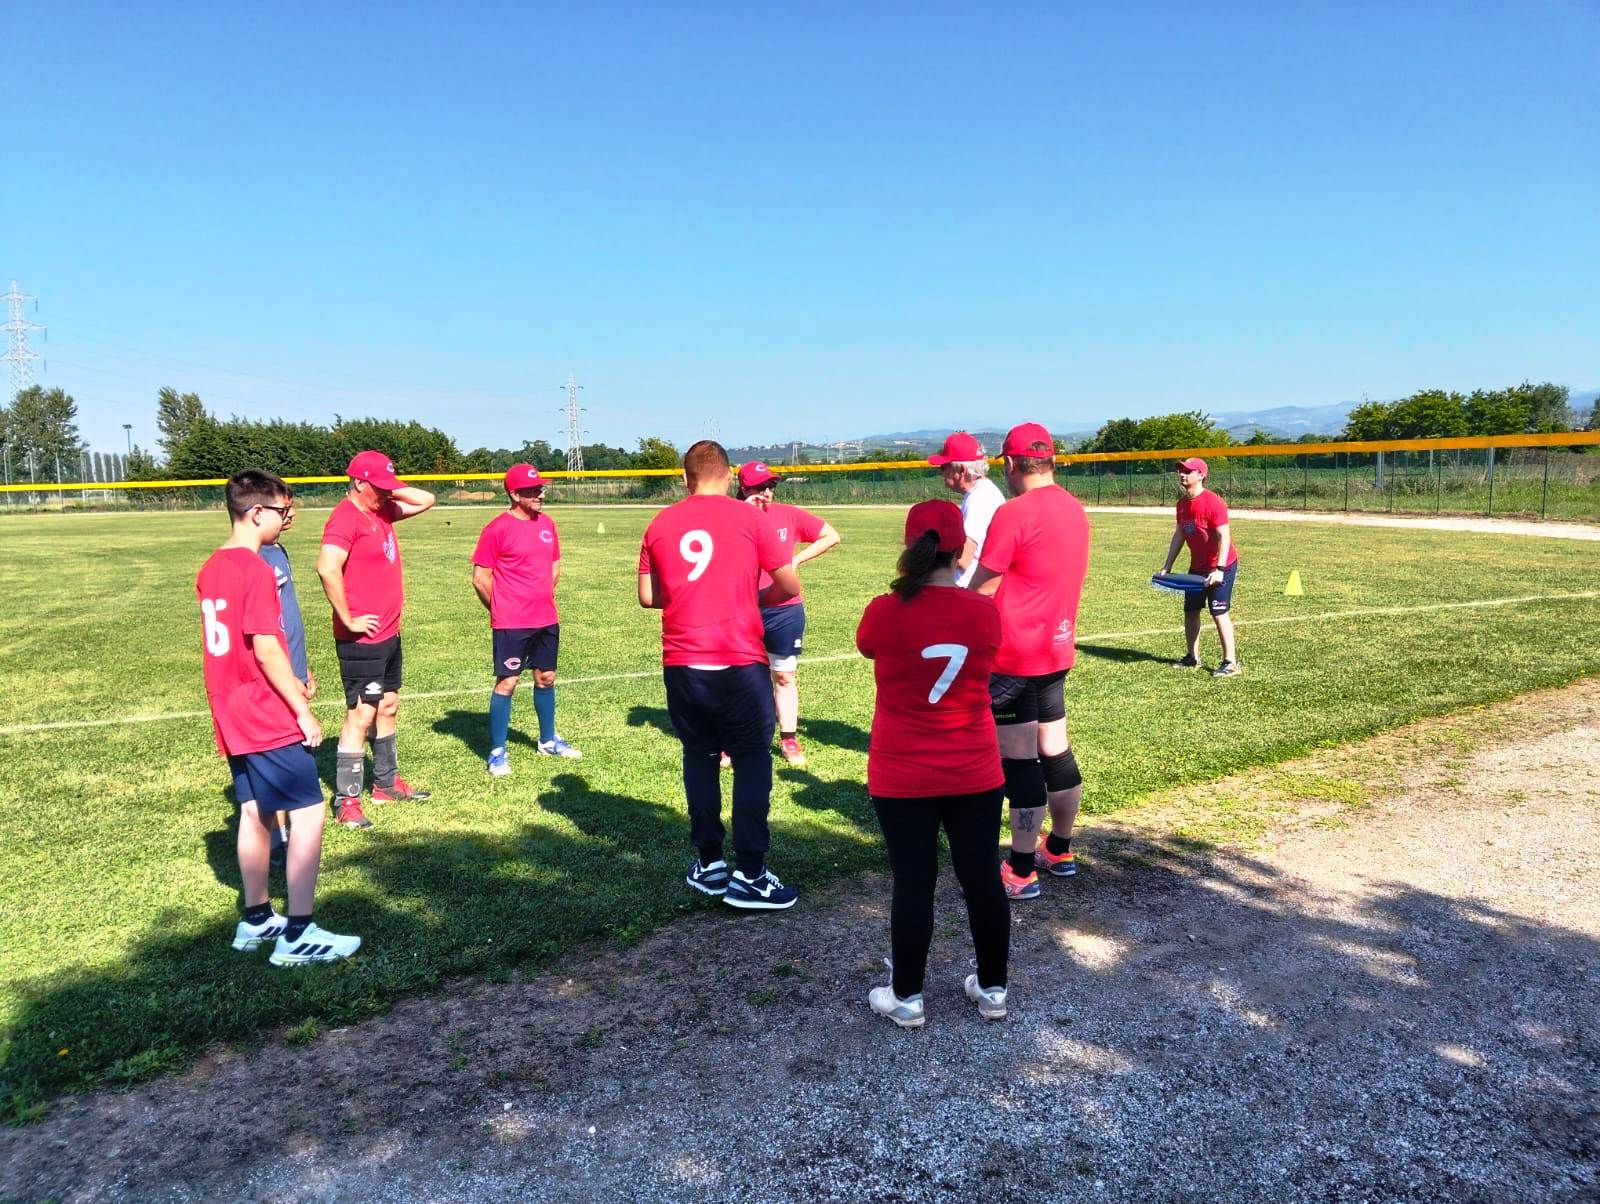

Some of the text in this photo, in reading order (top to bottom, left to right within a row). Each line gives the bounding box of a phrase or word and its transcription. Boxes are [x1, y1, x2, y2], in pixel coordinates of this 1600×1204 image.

[527, 469, 538, 478] C
[539, 529, 553, 543] C
[679, 529, 714, 582] 9
[920, 643, 969, 704] 7
